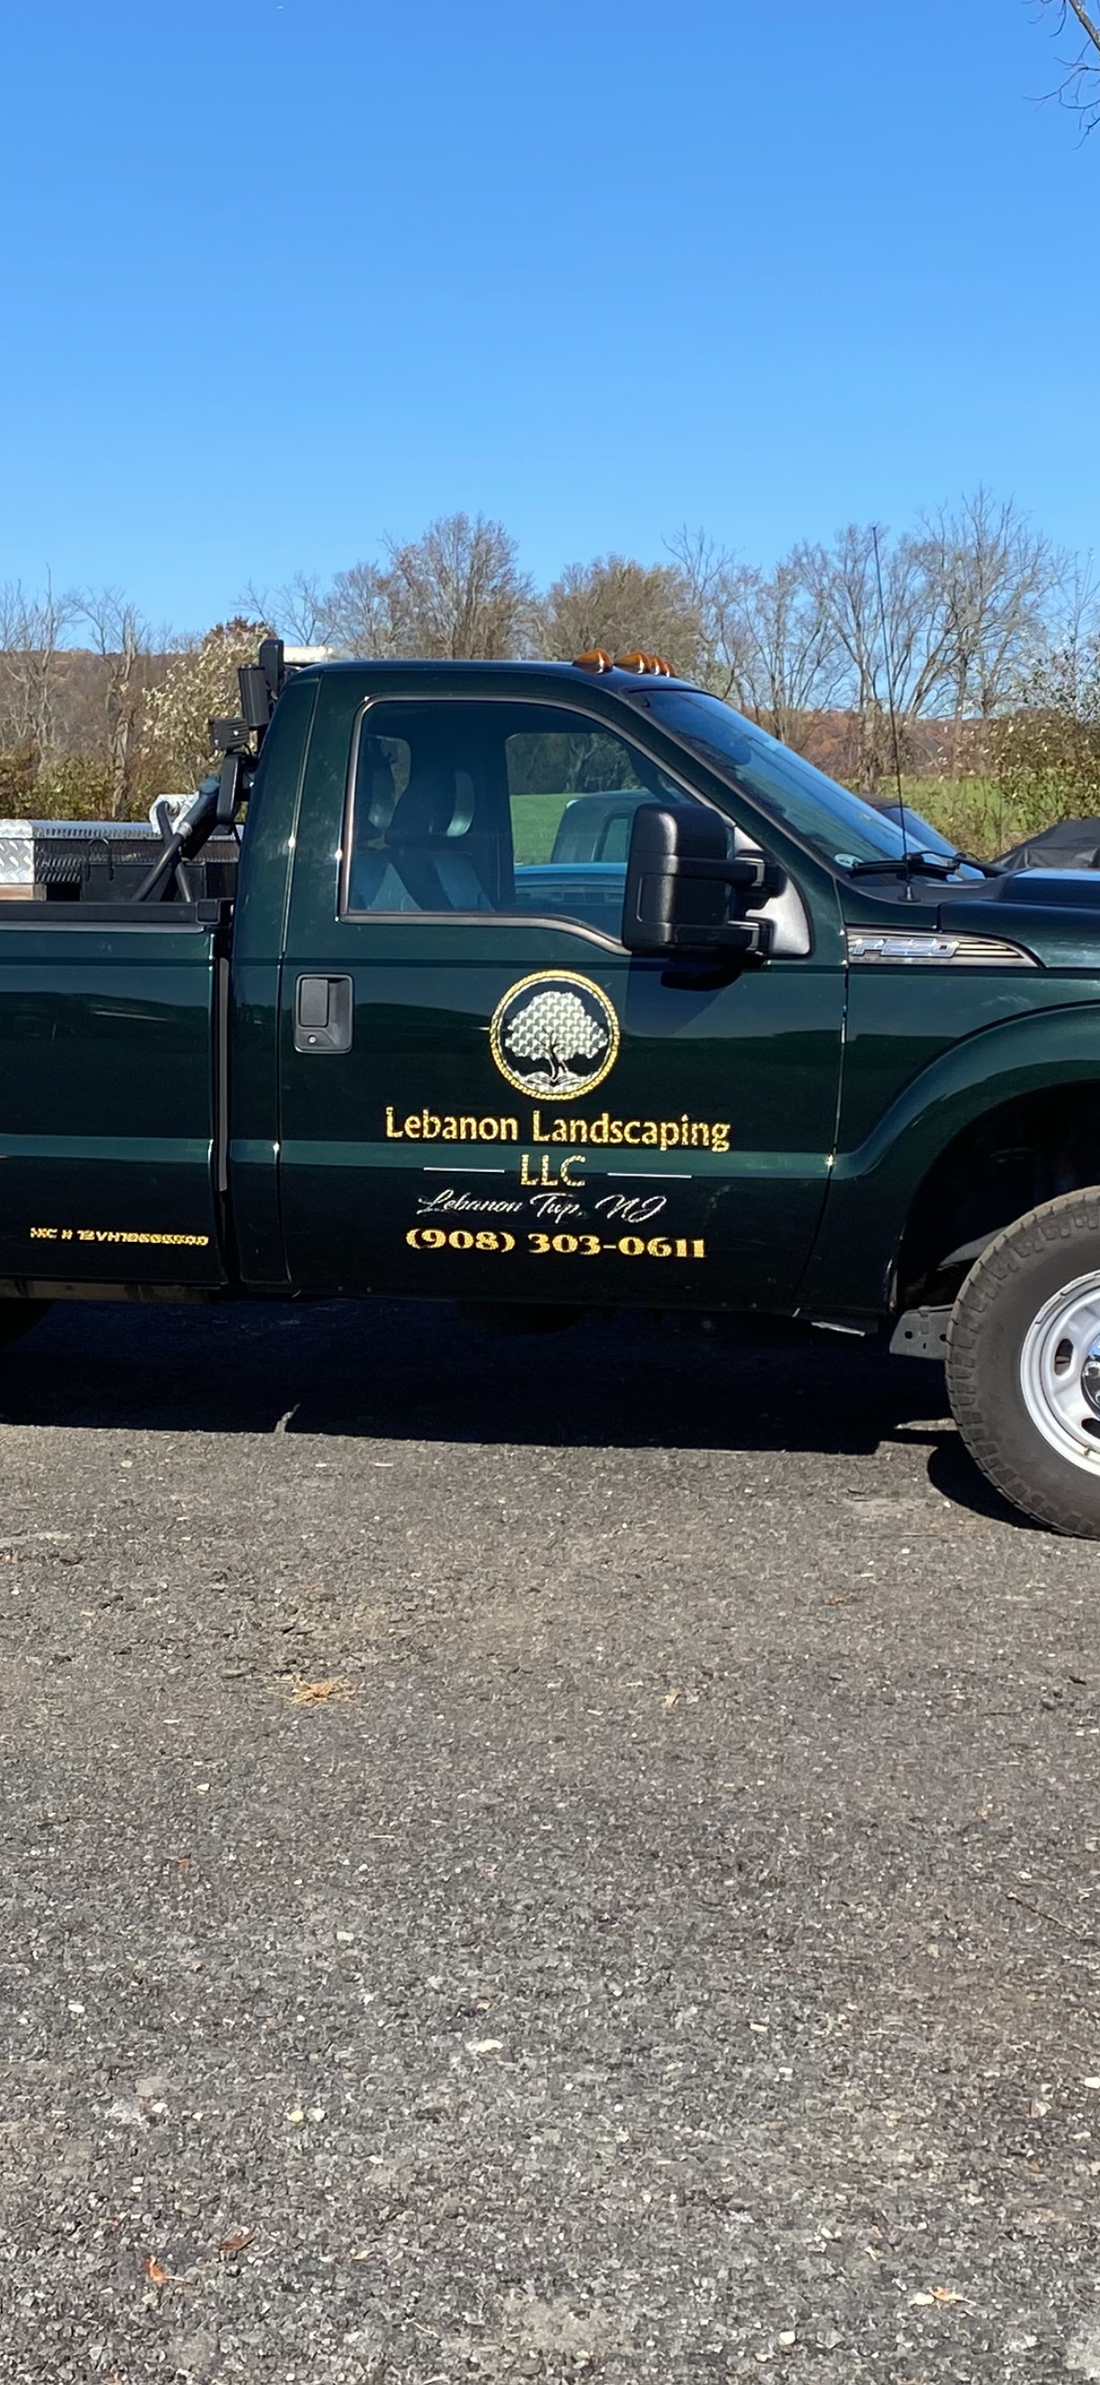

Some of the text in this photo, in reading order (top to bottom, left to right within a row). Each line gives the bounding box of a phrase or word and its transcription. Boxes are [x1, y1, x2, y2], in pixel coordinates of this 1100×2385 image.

[385, 1106, 731, 1153] Lebanon Landscaping
[519, 1154, 586, 1187] LLC
[416, 1189, 524, 1216] Lebanon
[594, 1194, 668, 1224] NJ
[405, 1228, 708, 1259] (908) 303-0611
